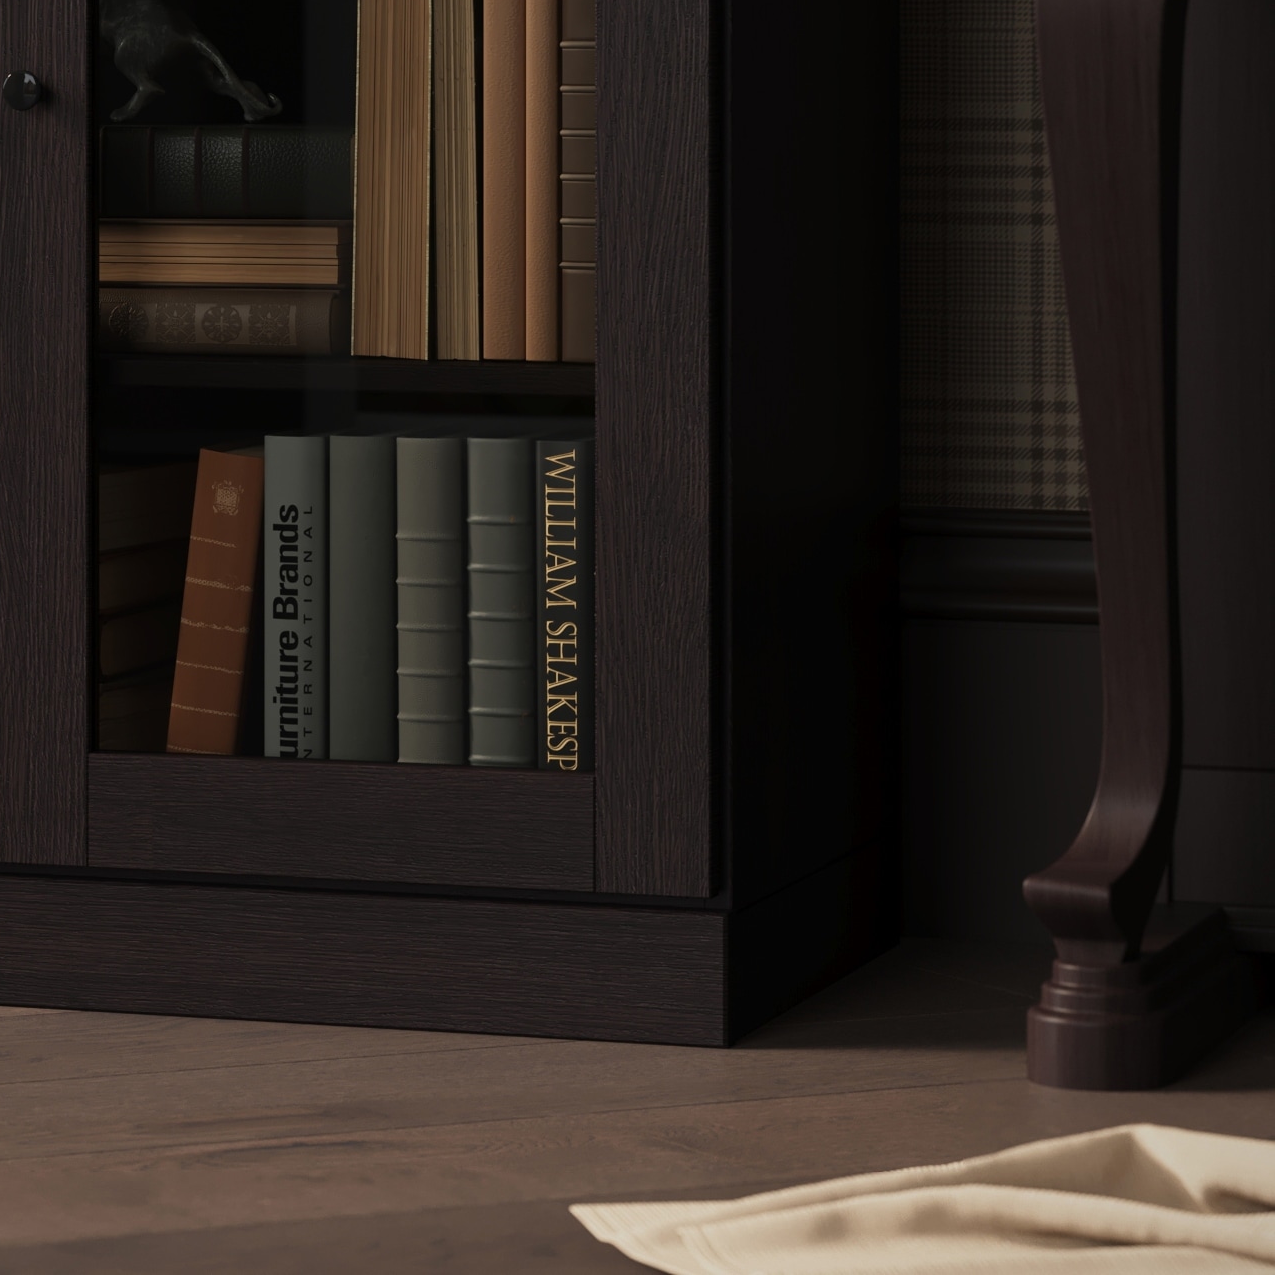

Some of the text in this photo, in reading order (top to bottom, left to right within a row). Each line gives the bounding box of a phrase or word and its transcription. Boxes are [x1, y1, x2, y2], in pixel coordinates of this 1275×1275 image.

[272, 505, 298, 620] Brands
[545, 449, 579, 770] WILLIAM SHAKESP
